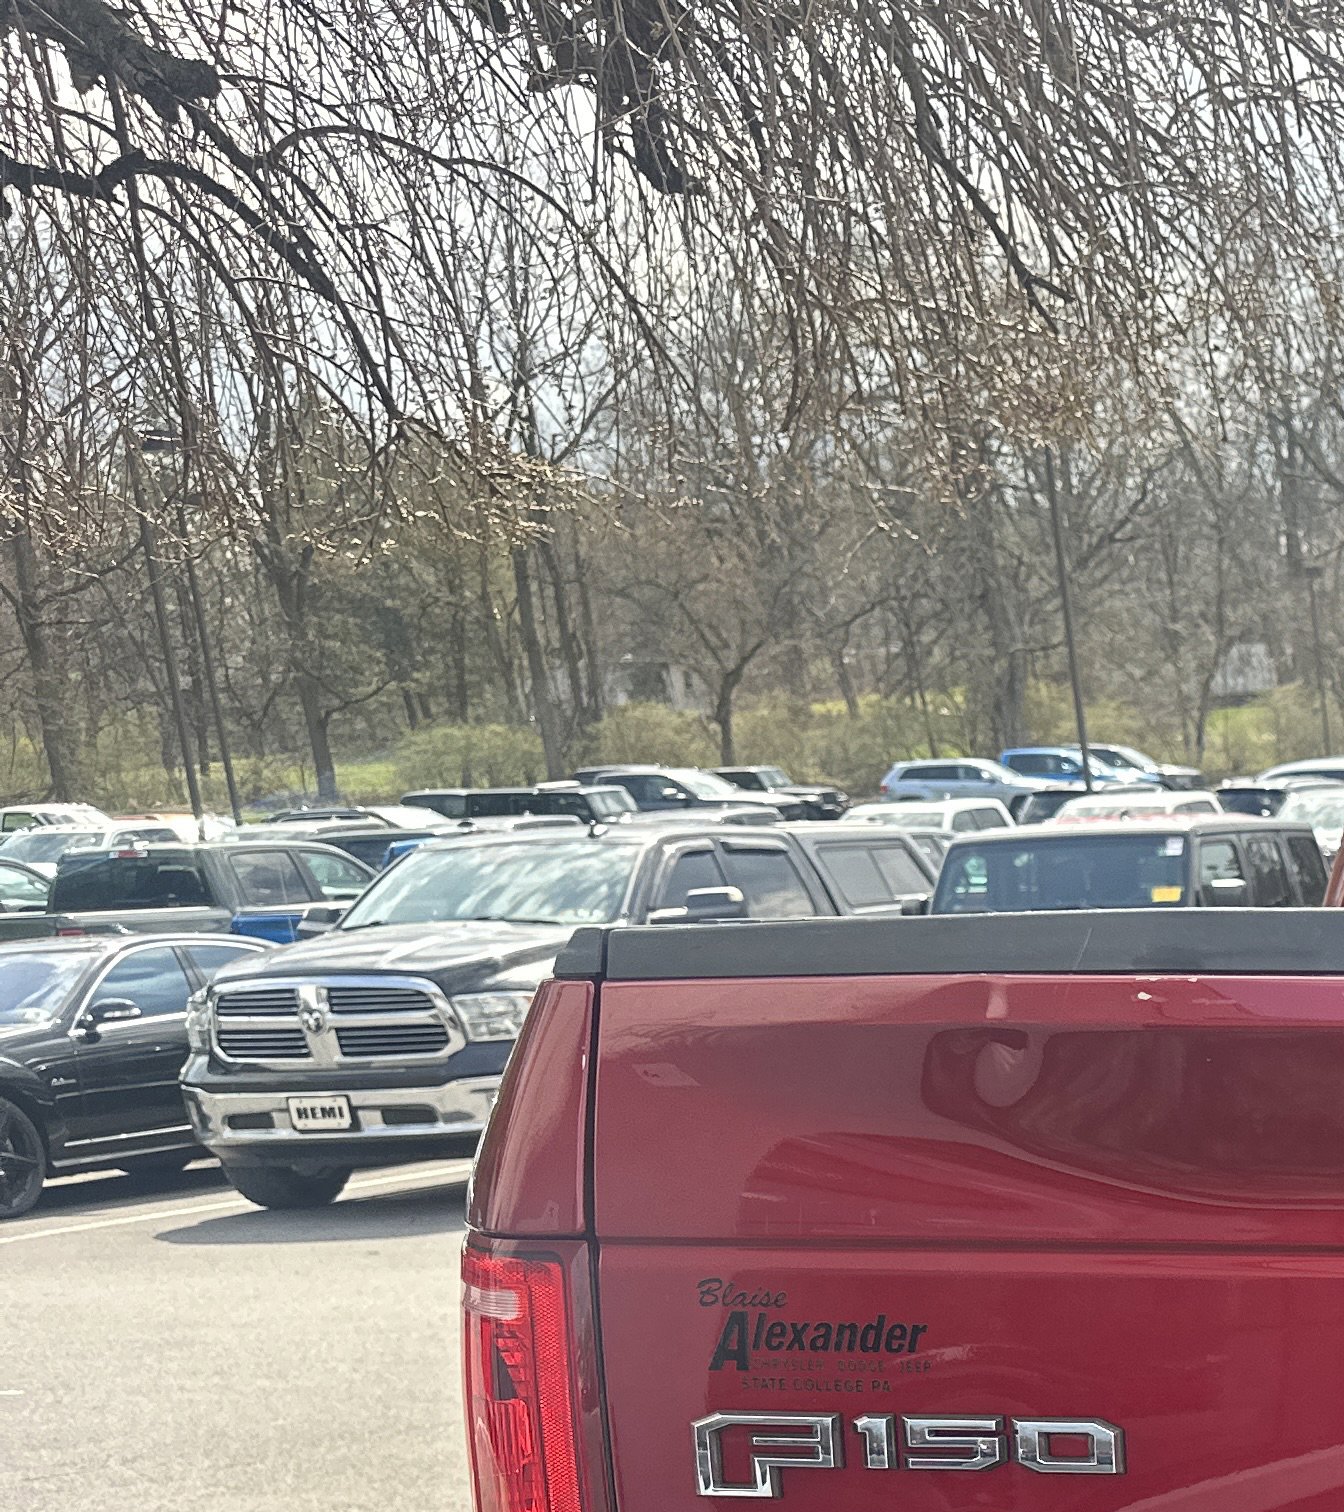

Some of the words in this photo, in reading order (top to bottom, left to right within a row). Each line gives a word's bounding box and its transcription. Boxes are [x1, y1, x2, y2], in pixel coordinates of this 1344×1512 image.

[296, 1106, 345, 1119] HEMI
[696, 1278, 789, 1309] Blaise
[708, 1311, 928, 1371] Alexander
[837, 1359, 886, 1373] DODGE
[899, 1359, 932, 1374] JEEP
[741, 1377, 787, 1391] STATE
[793, 1378, 864, 1392] COLLEGE
[871, 1380, 892, 1392] PA
